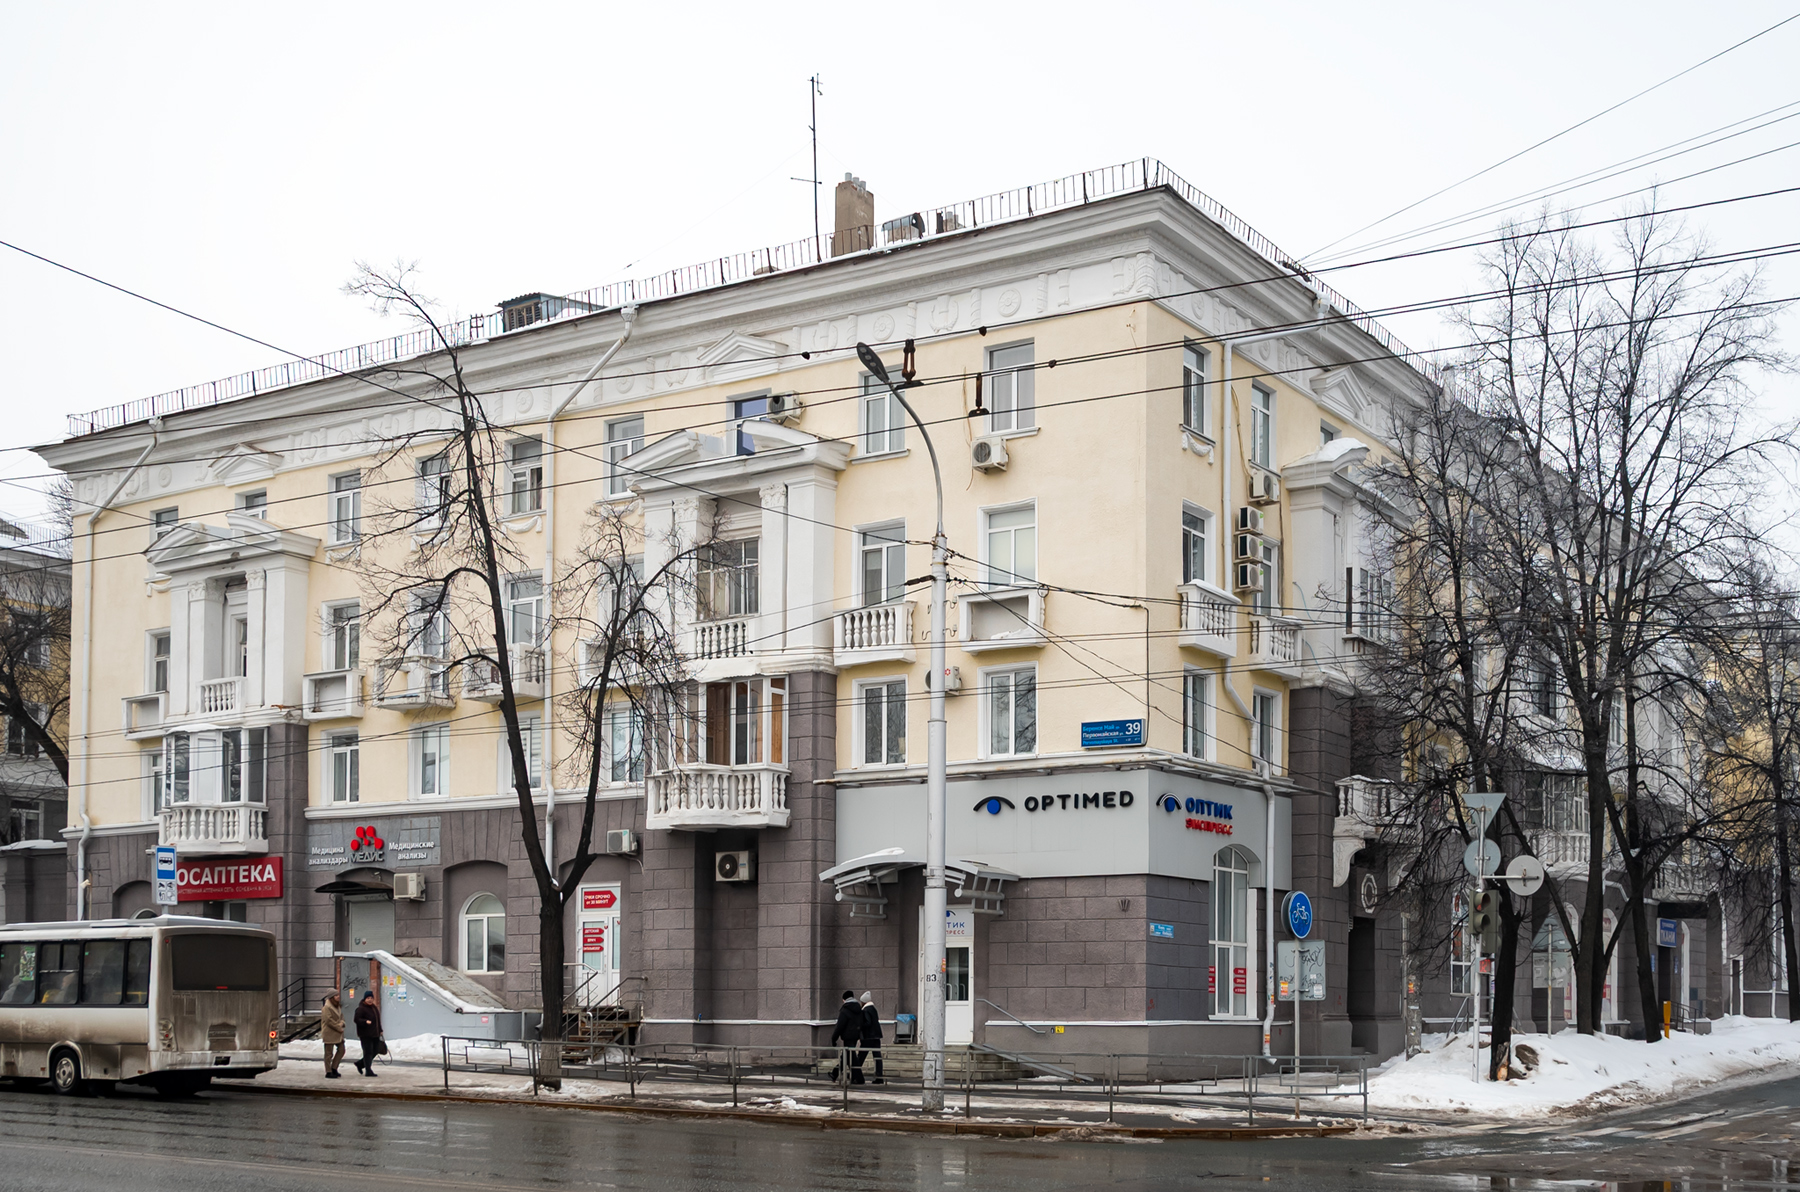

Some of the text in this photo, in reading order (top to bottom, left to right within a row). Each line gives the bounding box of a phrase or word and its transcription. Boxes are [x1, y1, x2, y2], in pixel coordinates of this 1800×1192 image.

[1125, 722, 1141, 735] 39
[1024, 790, 1134, 812] OPTIMED
[1185, 797, 1233, 820] ОПТИК
[1185, 818, 1233, 835] ЭКСПРЕСС
[311, 847, 345, 855] Медицина
[388, 841, 435, 851] Медицинские
[350, 851, 385, 863] МЕДИС
[397, 851, 427, 860] анализы
[177, 864, 276, 886] ОСАПТЕКА
[1660, 930, 1676, 943] ТКАНИ
[926, 973, 937, 982] 83
